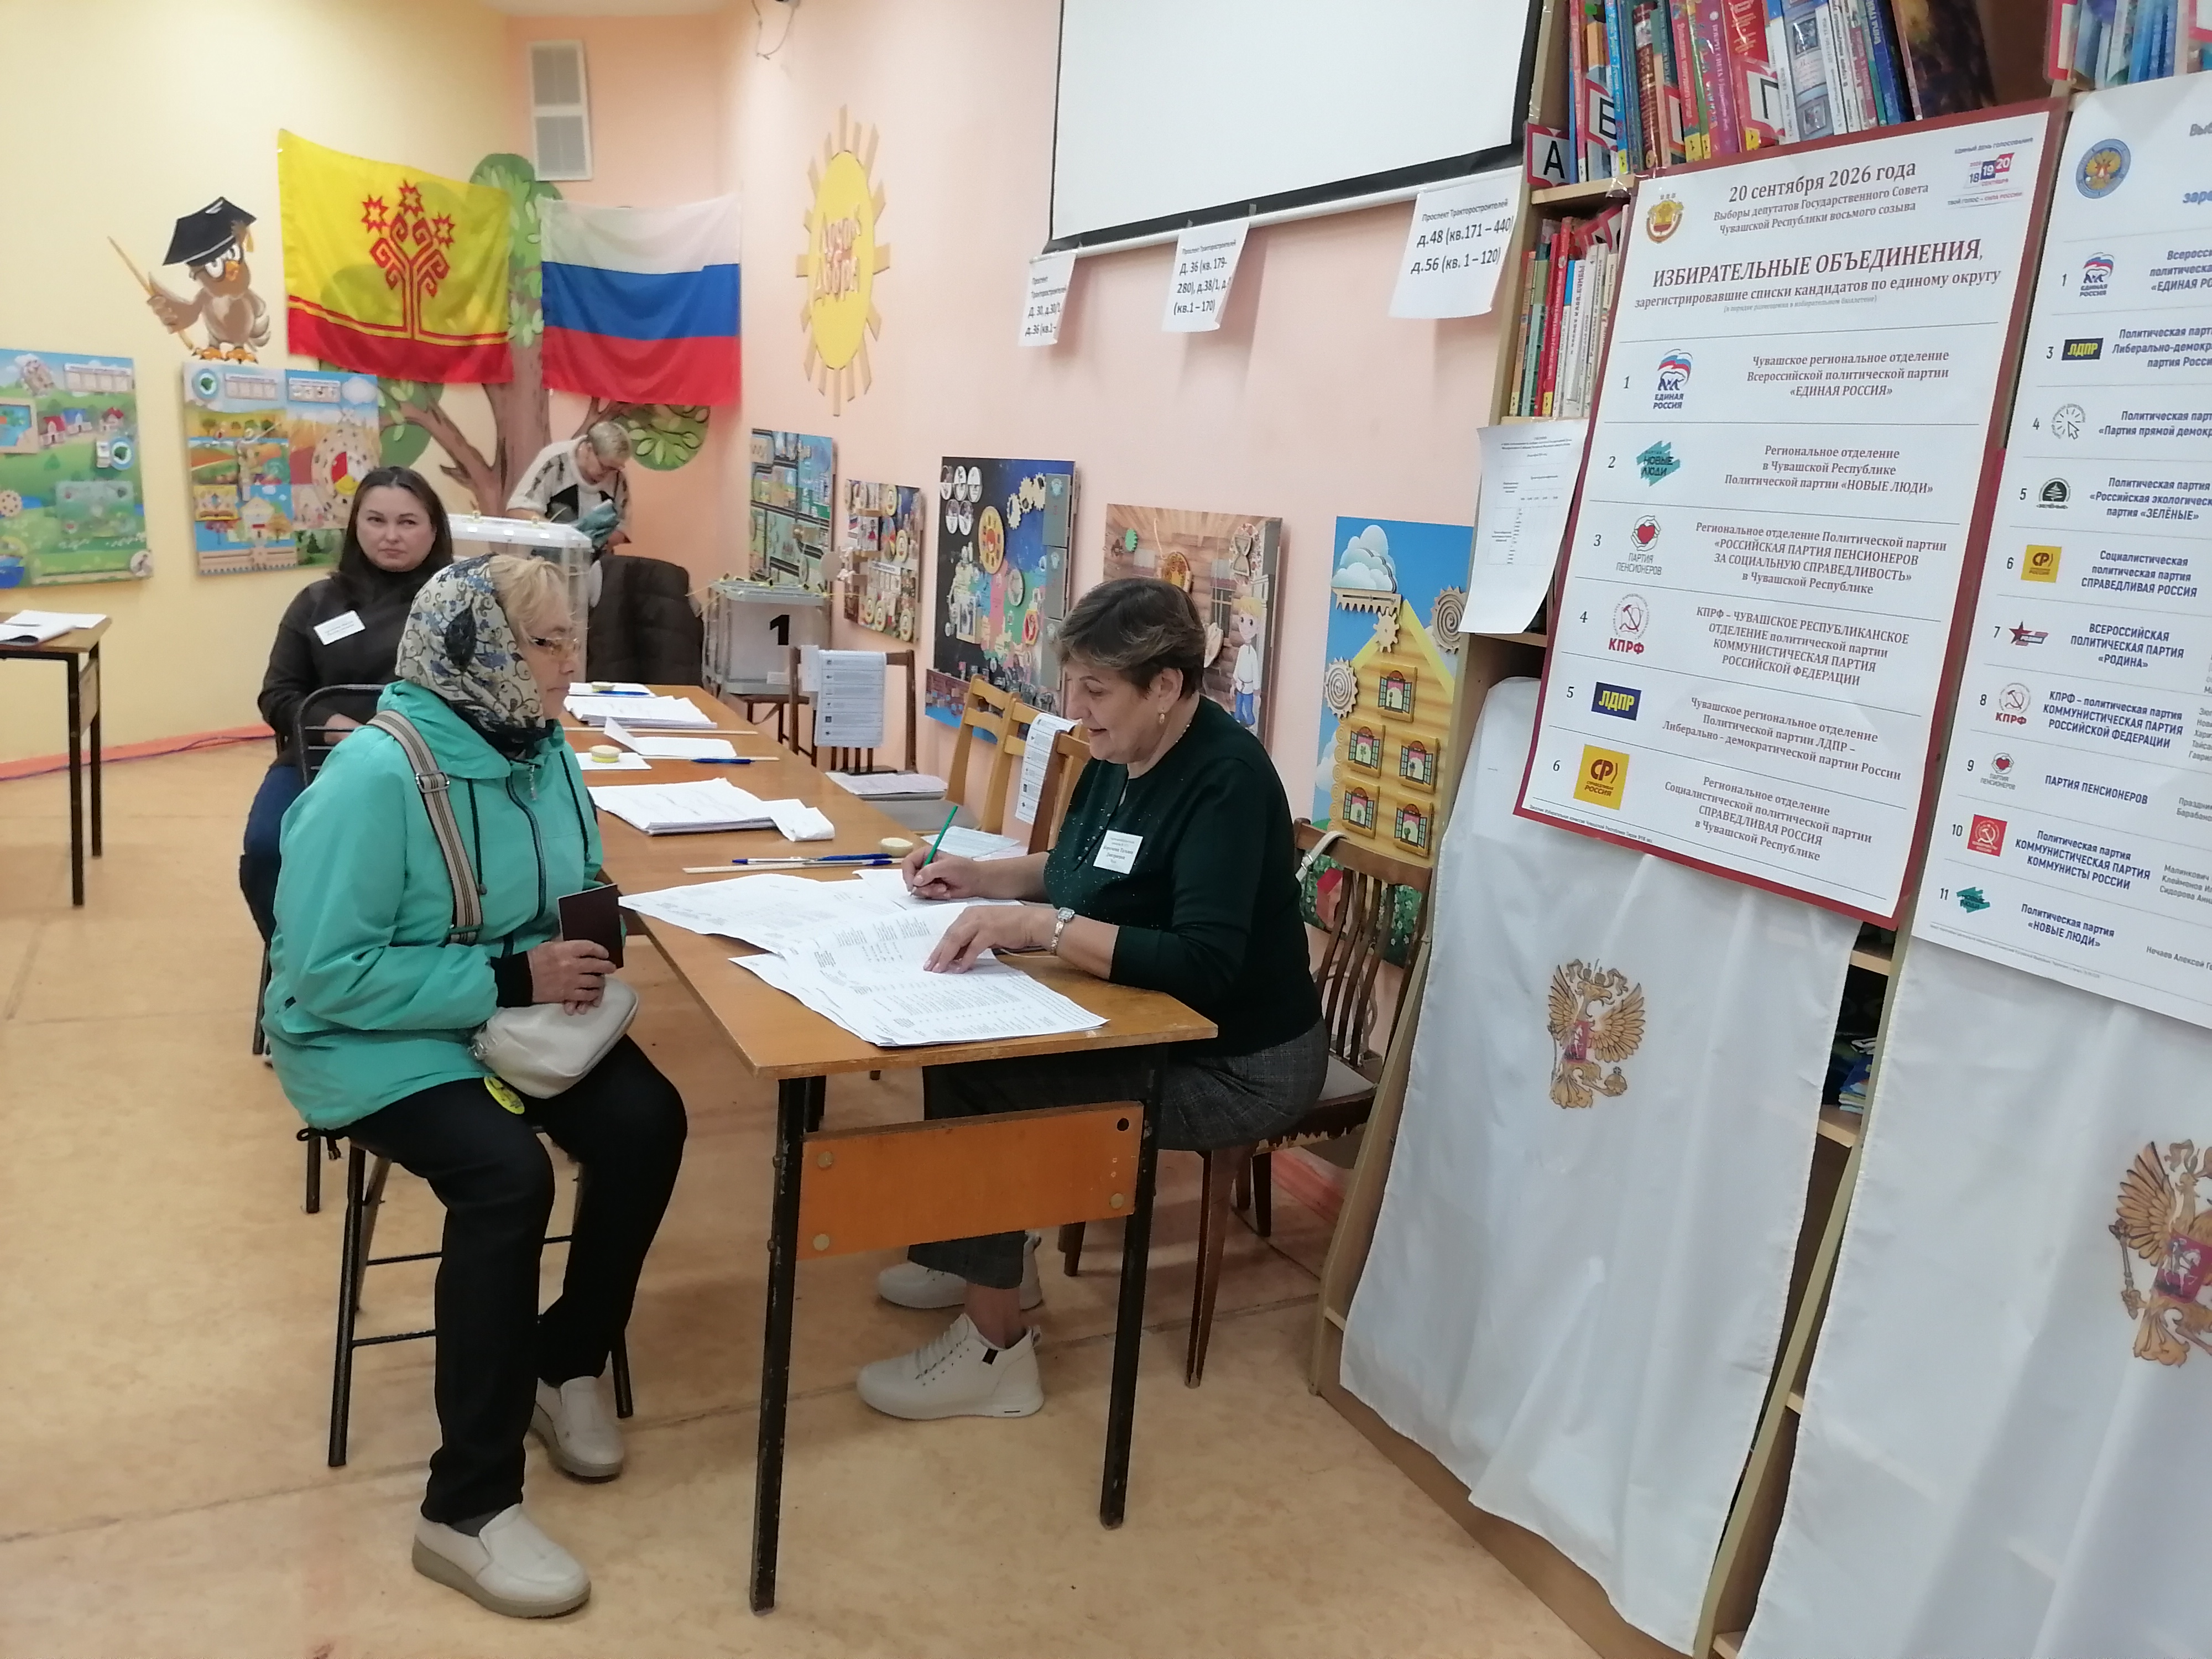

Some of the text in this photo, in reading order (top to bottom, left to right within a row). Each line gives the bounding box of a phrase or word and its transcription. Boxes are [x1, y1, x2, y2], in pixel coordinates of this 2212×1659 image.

[1543, 140, 1566, 179] А
[1996, 157, 2011, 169] 20
[1969, 173, 1980, 184] 18
[1983, 165, 1994, 176] 19
[1728, 163, 1916, 203] 20 сентября 2026 года
[1713, 185, 1928, 221] Выборы депутатов Государственного Совета
[2182, 190, 2212, 205] заре
[1422, 199, 1508, 222] Проспект Тракторостроителей
[1720, 202, 1916, 236] Чувашской Республики восьмого созыва
[1417, 216, 1514, 248] д.48 (кв.171 440)
[1180, 263, 1188, 276] Д.
[1190, 261, 1198, 273] 36
[1199, 260, 1212, 274] (кв.
[1411, 247, 1501, 274] д.56 (кв. 1 120)
[1652, 238, 1983, 288] ИЗБИРАТЕЛЬНЫЕ ОБЪЕДИНЕНИЯ,
[2062, 273, 2068, 287] 1
[2151, 277, 2212, 293] «ЕДИНАЯ РО
[1634, 291, 1749, 310] зарегистрировавшие
[1750, 288, 1792, 299] списки
[1794, 281, 1868, 297] кандидатов
[1871, 280, 1887, 290] по
[1890, 274, 1949, 291] единому
[1952, 270, 2001, 286] округу
[1202, 299, 1215, 313] 170)
[2046, 346, 2054, 359] 3
[2067, 342, 2098, 357] ЛДПР
[1753, 352, 1949, 369] Чувашское региональное отделение
[1623, 375, 1630, 389] 1
[1746, 368, 1949, 384] Всероссийской политической партии
[1654, 393, 1684, 401] ЕДИНАЯ
[1790, 385, 1893, 399] «ЕДИНАЯ РОССИЯ»
[1652, 401, 1683, 410] РОССИЯ
[2032, 418, 2040, 431] 4
[2098, 425, 2211, 439] «Партия прямой демокр
[1607, 456, 1616, 468] 2
[1771, 461, 1897, 477] Чувашской Республике
[1724, 474, 1933, 495] Политической партии «НОВЫЕ ЛЮДИ»
[2108, 477, 2211, 493] Политическая партия
[2018, 488, 2028, 500] 5
[2106, 507, 2199, 521] партия «ЗЕЛЁНЫЕ»
[1593, 534, 1602, 547] 3
[1628, 552, 1654, 564] ПАРТИЯ
[1714, 539, 1919, 566] «РОССИЙСКАЯ ПАРТИЯ ПЕНСИОНЕРОВ
[2100, 550, 2189, 567] Социалистическая
[1616, 562, 1662, 576] ПЕНСИОНЕРОВ
[1714, 552, 1912, 581] ЗА СОЦИАЛЬНУЮ СПРАВЕДЛИВОСТЬ»
[2006, 556, 2015, 570] 6
[2081, 577, 2198, 598] СПРАВЕДЛИВАЯ РОССИЯ
[1579, 611, 1588, 623] 4
[1696, 606, 1910, 644] КПРФ ЧУВАШСКОЕ РЕСПУБЛИКАНСКОЕ
[770, 614, 790, 646] 1
[1993, 625, 2001, 639] 7
[2089, 623, 2170, 642] ВСЕРОССИЙСКАЯ
[1608, 637, 1645, 655] КПРФ
[1713, 638, 1877, 672] КОММУНИСТИЧЕСКАЯ ПАРТИЯ
[2098, 654, 2148, 668] «РОДИНА»
[1721, 654, 1861, 686] РОССИЙСКОЙ ФЕДЕРАЦИИ
[1566, 686, 1575, 698] 5
[1979, 693, 1987, 706] 8
[1599, 690, 1635, 712] ЛДПР
[2048, 691, 2183, 721] КПРФ политическая партия
[1995, 712, 2027, 725] КПРФ
[1703, 714, 1848, 752] Политической партии ЛДПР
[1662, 721, 1901, 780] Либерально демократической партии России
[1553, 759, 1561, 771] 6
[1966, 759, 1975, 772] 9
[1584, 785, 1612, 797] РОССИЯ
[2044, 775, 2148, 805] ПАРТИЯ ПЕНСИОНЕРОВ
[1665, 781, 1872, 843] Социалистической политической партии
[1699, 805, 1823, 846] СПРАВЕДЛИВАЯ РОССИЯ
[1952, 823, 1963, 837] 10
[2027, 855, 2131, 890] КОММУНИСТЫ РОССИИ
[1940, 887, 1949, 901] 11
[2027, 920, 2101, 947] «НОВЫЕ ЛЮДИ»
[2173, 953, 2205, 968] Алексей
